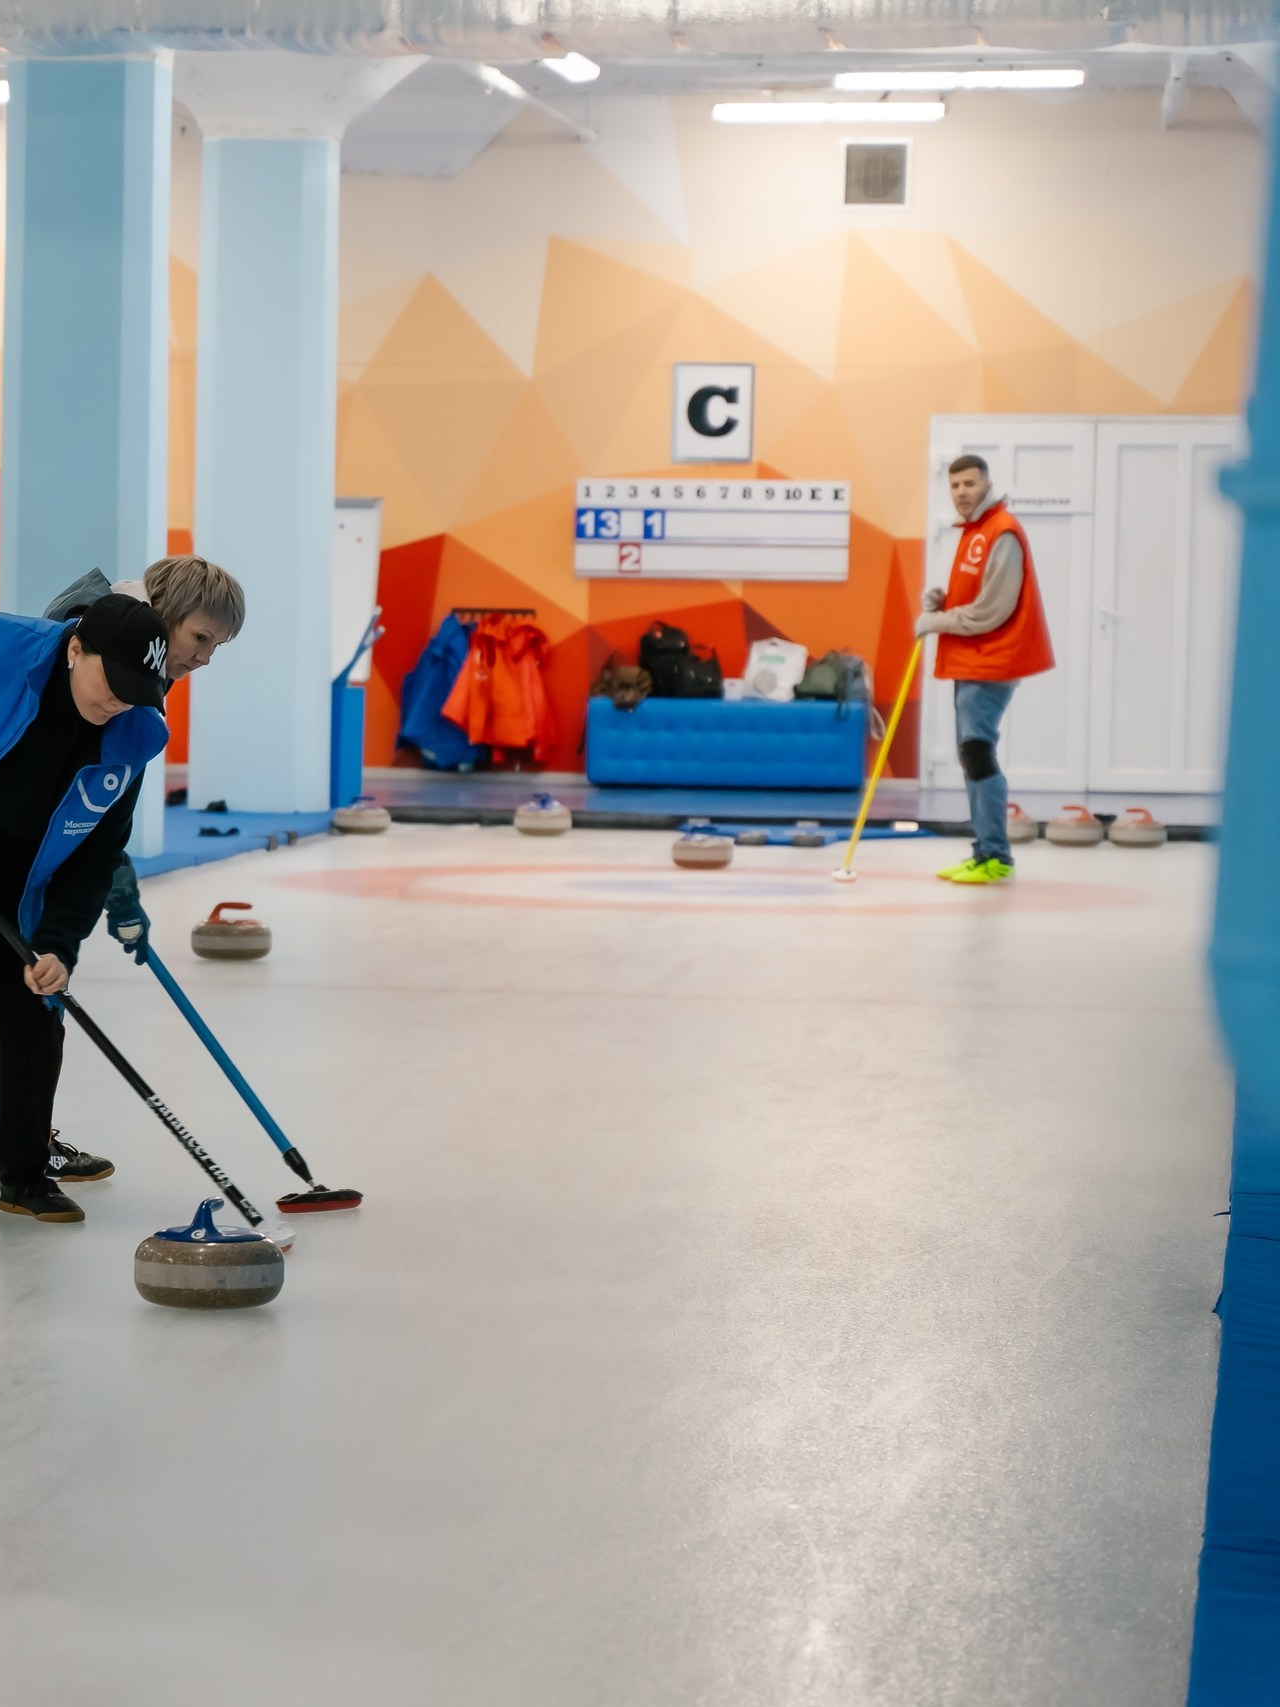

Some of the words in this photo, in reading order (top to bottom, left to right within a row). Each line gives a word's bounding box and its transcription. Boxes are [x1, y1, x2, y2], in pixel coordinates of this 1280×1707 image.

[687, 386, 738, 437] C
[584, 486, 592, 498] 1
[606, 486, 616, 498] 2
[628, 486, 638, 498] 3
[651, 486, 661, 498] 4
[674, 486, 684, 498] 5
[697, 486, 707, 499] 6
[719, 486, 729, 499] 7
[742, 487, 752, 499] 8
[765, 487, 775, 500] 9
[785, 488, 802, 500] 10
[810, 488, 822, 500] E
[833, 488, 845, 500] E
[646, 511, 663, 537] 1
[621, 544, 641, 570] 2
